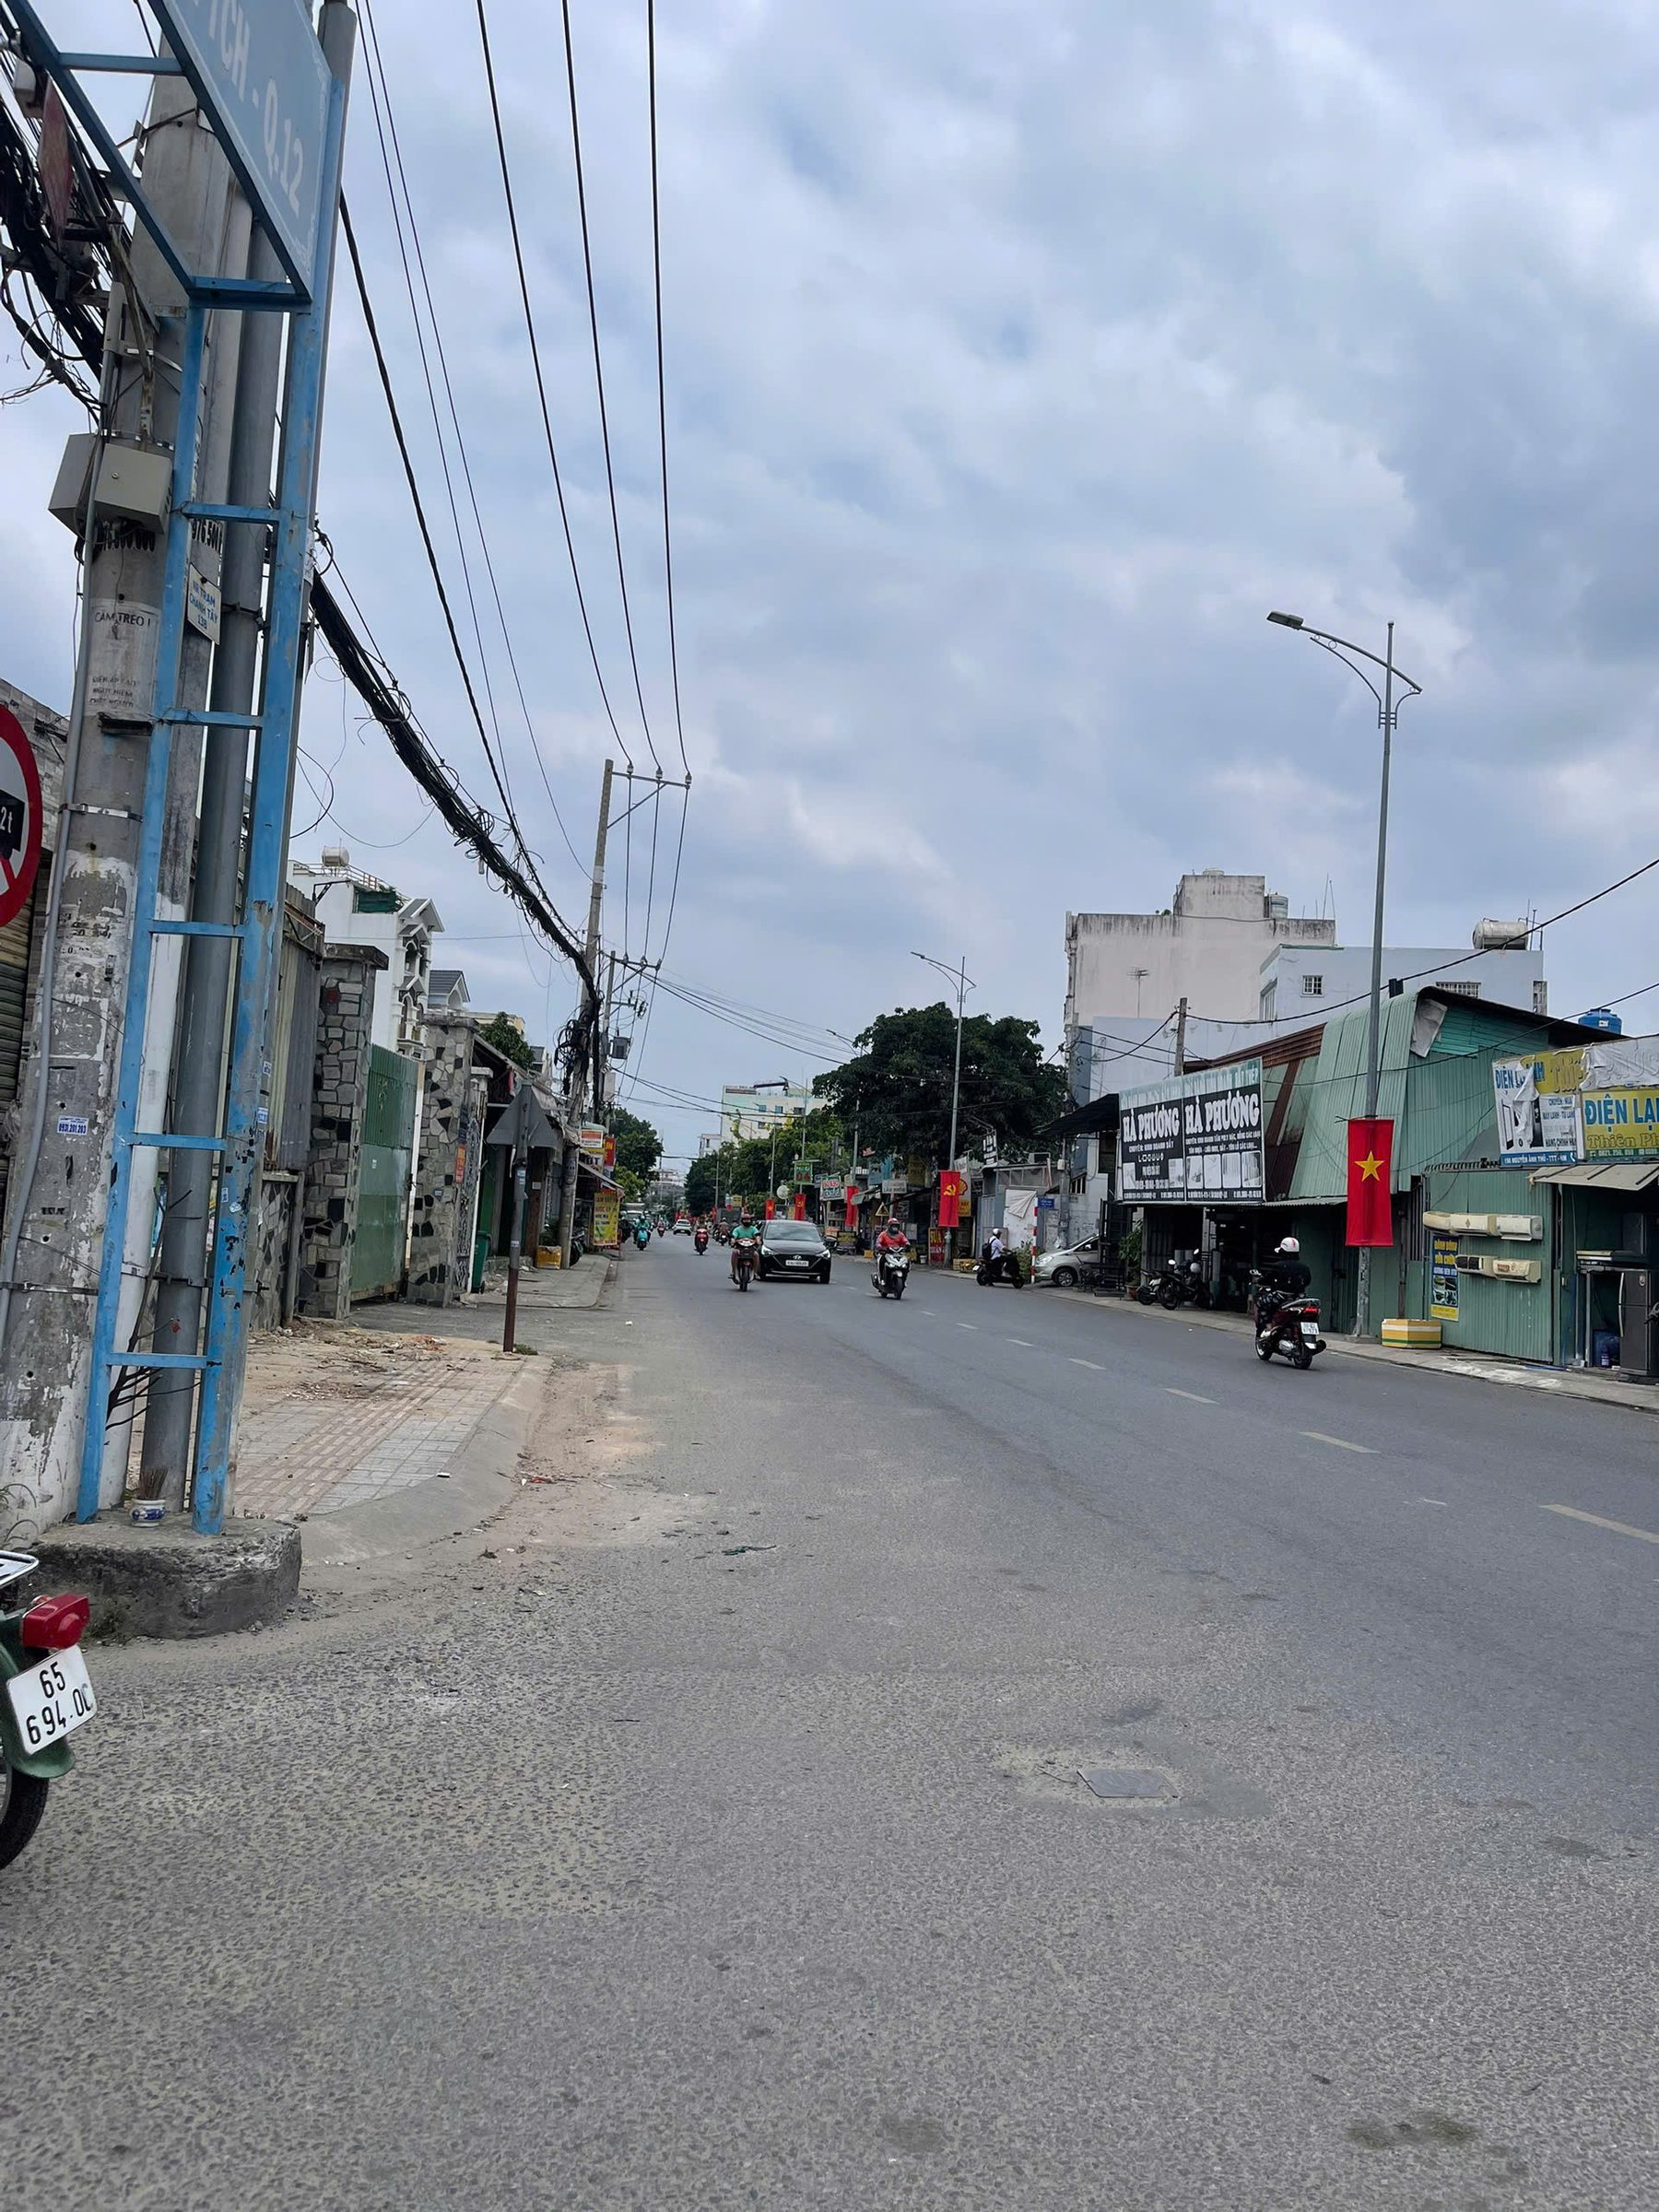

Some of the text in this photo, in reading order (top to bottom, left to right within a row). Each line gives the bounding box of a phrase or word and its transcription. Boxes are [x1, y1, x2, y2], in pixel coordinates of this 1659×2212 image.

[264, 78, 304, 218] Q.12
[117, 612, 145, 627] TREO
[1123, 1109, 1136, 1143] HÀ
[1185, 1096, 1204, 1135] HÀ
[1584, 1093, 1659, 1133] ĐIỆN LẠ
[1587, 1134, 1637, 1148] Thiên
[40, 1661, 65, 1698] 65
